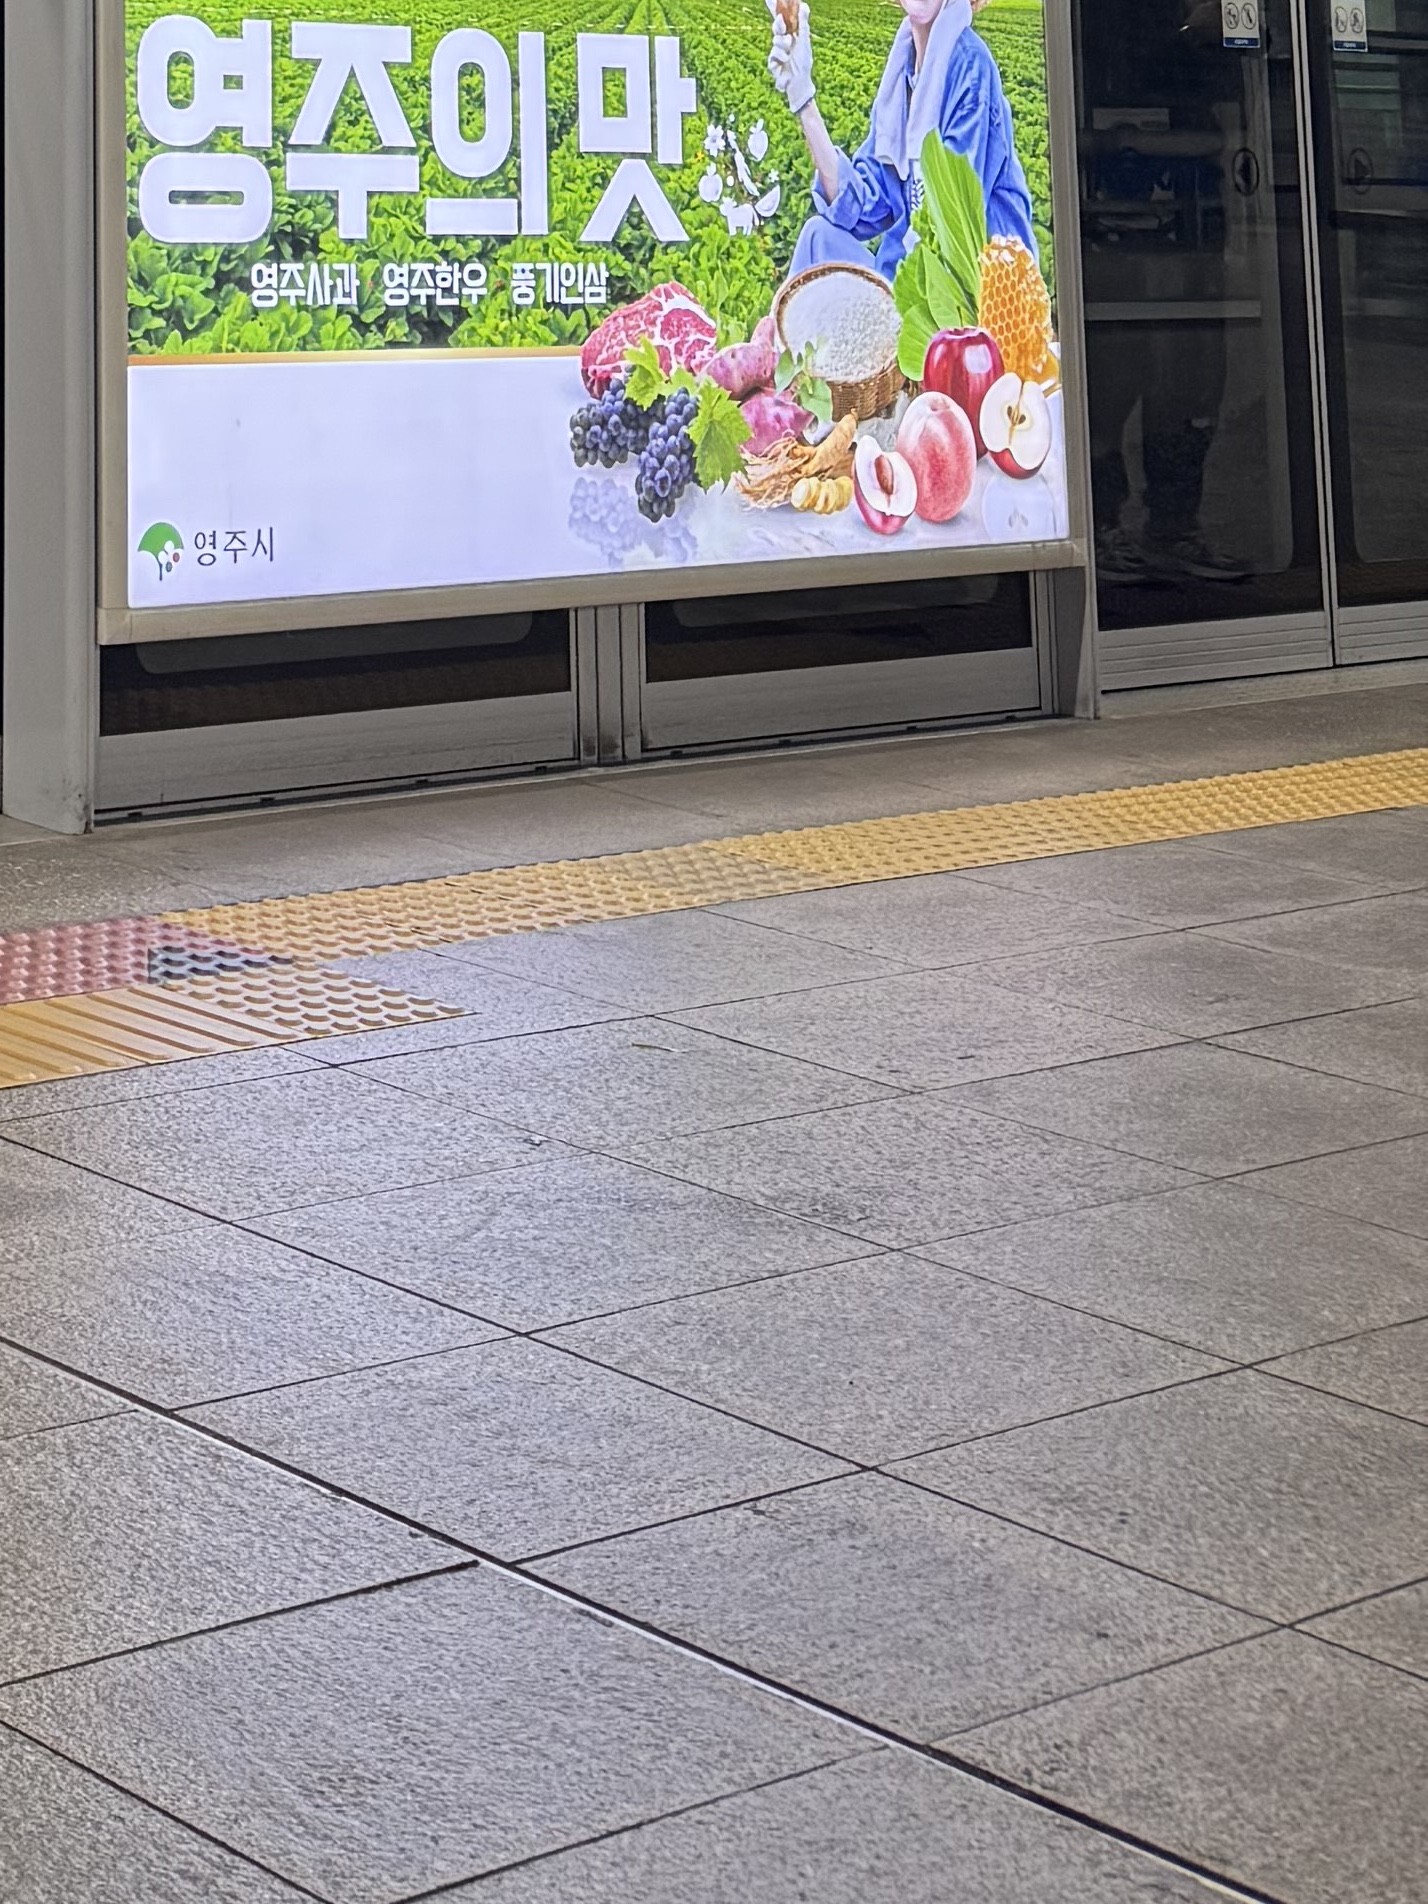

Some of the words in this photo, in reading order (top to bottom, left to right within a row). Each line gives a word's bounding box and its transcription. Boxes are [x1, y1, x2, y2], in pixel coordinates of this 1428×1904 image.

[136, 14, 549, 244] 영주의
[576, 32, 698, 243] 맛
[250, 262, 360, 308] 영주사과
[382, 262, 488, 306] 영주한우
[511, 262, 609, 305] 풍기인삼
[194, 526, 274, 566] 영주시
